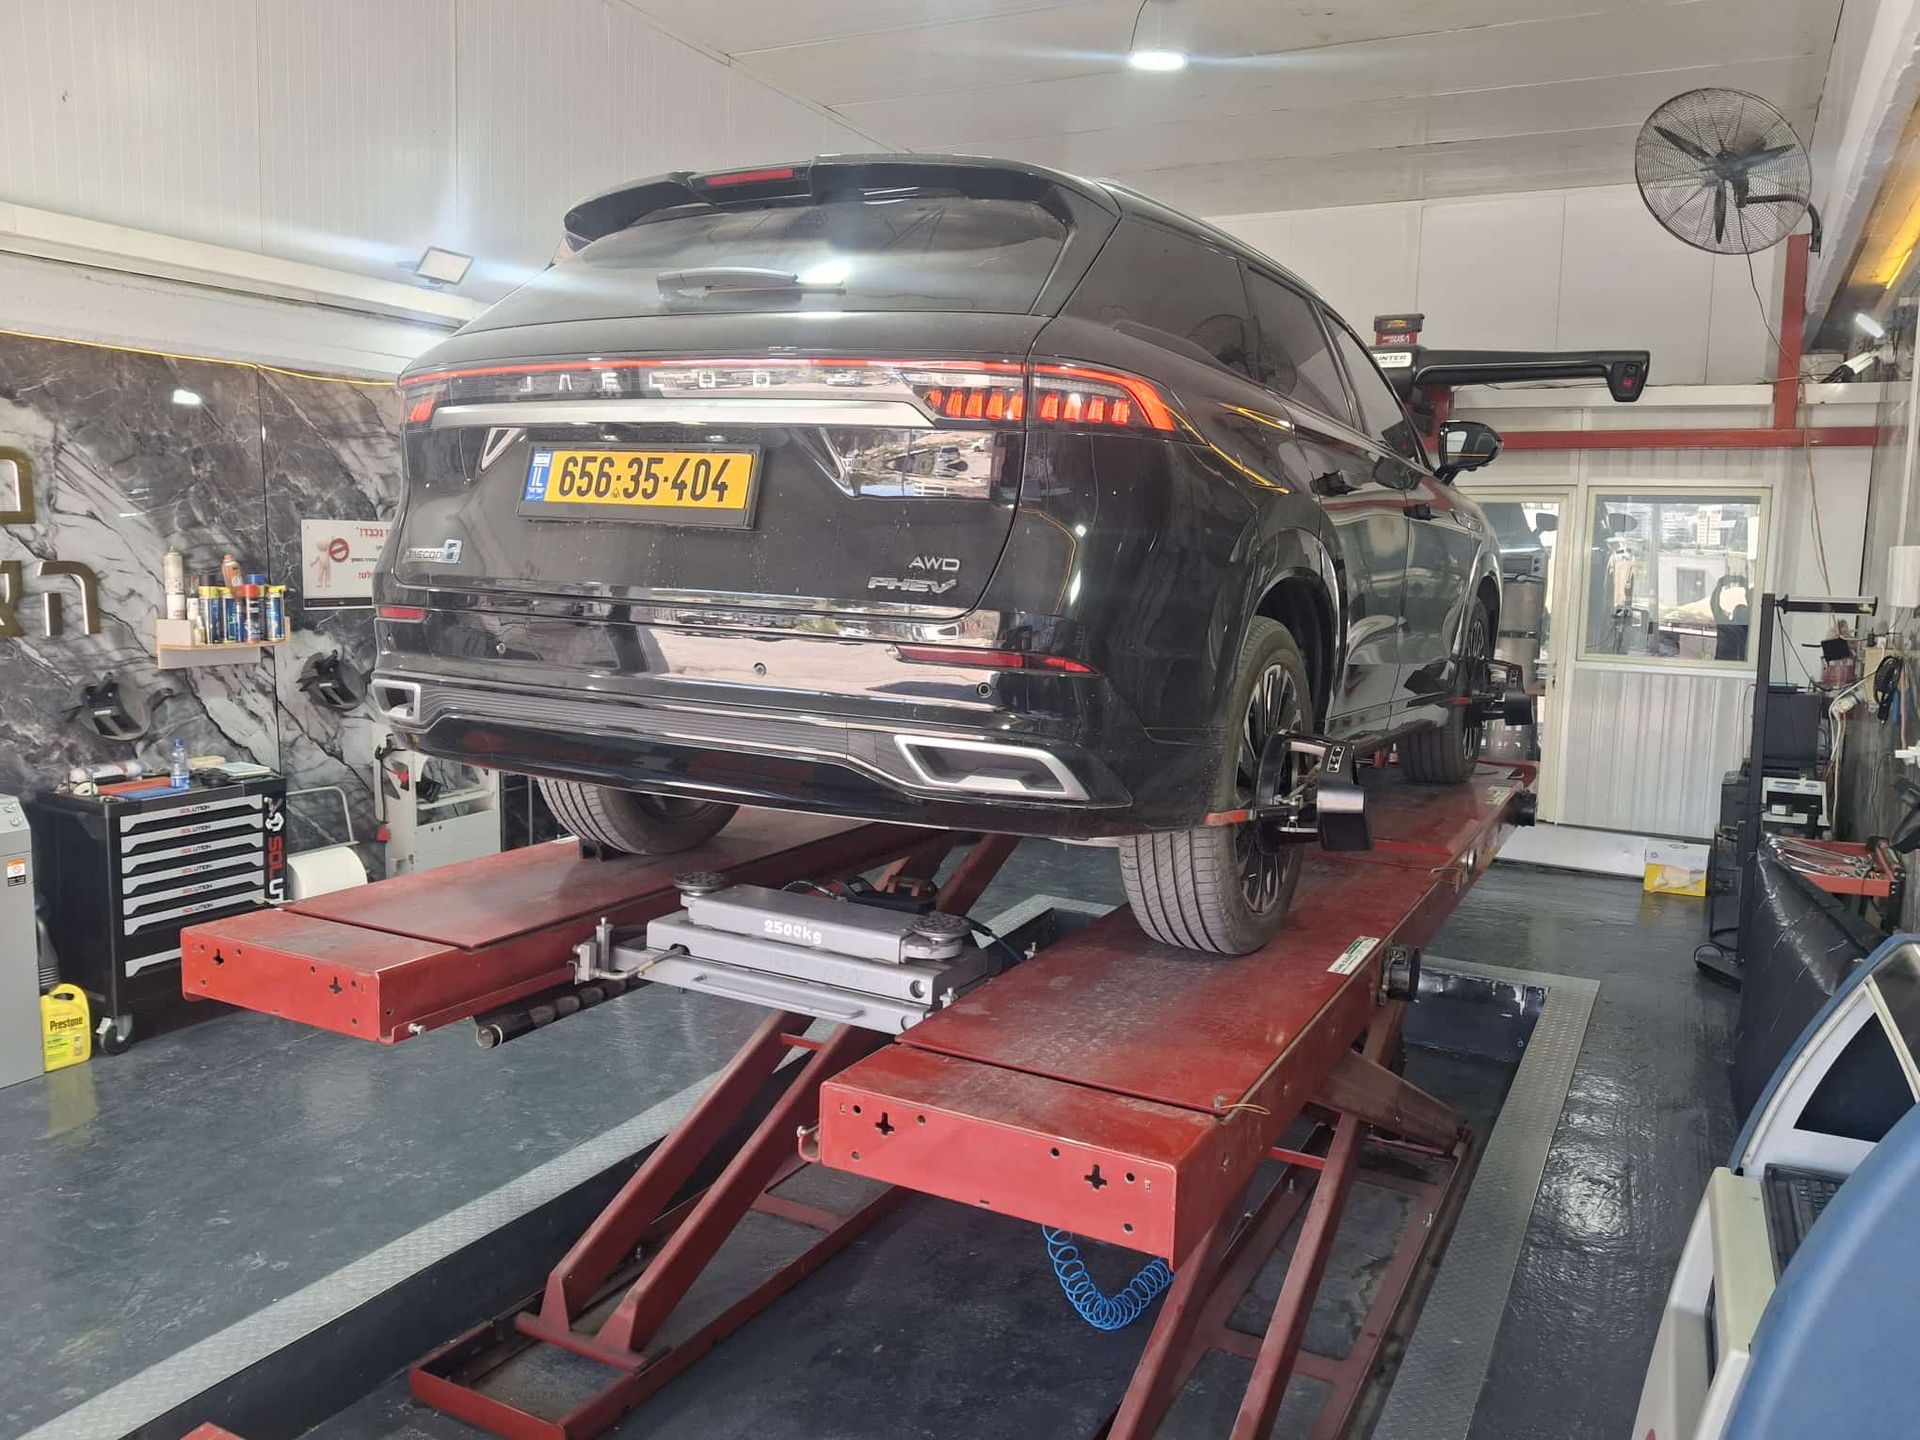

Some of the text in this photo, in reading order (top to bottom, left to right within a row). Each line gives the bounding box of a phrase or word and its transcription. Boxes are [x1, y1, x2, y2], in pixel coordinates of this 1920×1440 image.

[531, 467, 544, 487] IL
[909, 556, 960, 571] AWD
[867, 576, 957, 594] PHEV
[763, 919, 822, 945] 2500kg
[49, 1016, 84, 1032] Prestone
